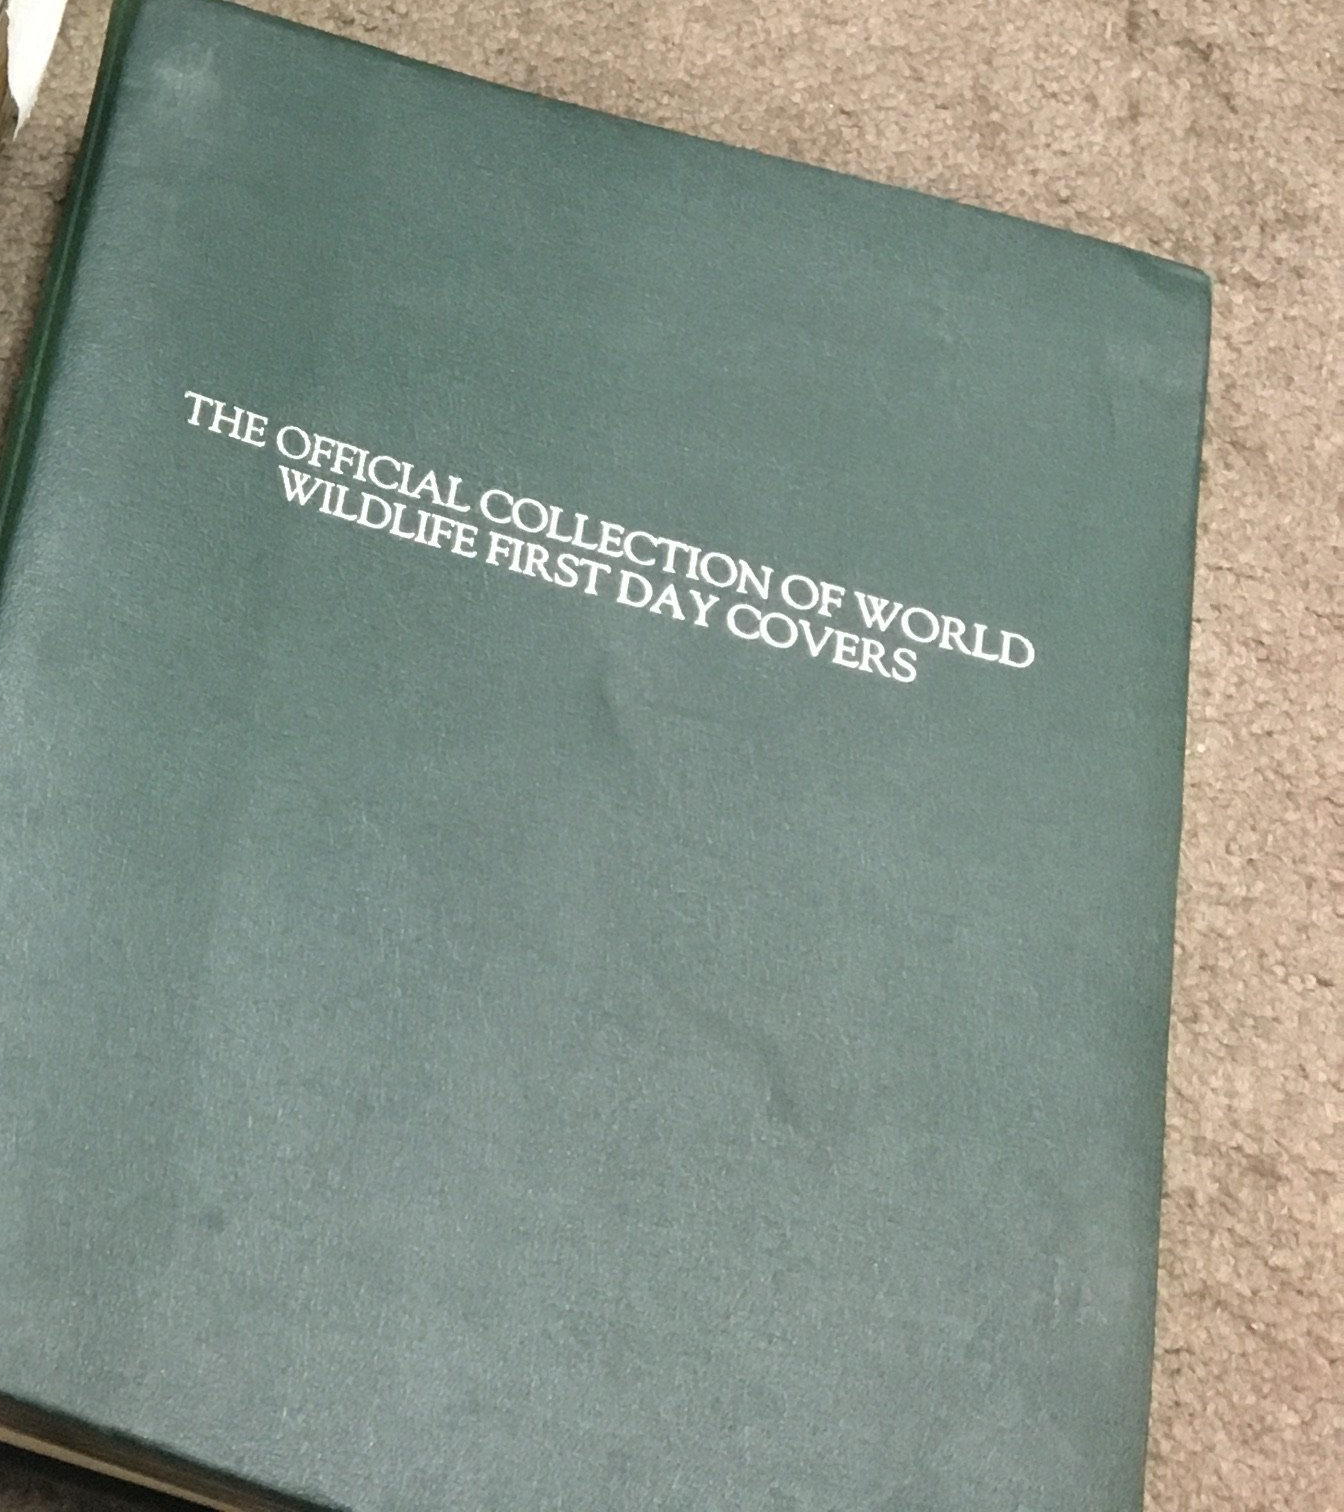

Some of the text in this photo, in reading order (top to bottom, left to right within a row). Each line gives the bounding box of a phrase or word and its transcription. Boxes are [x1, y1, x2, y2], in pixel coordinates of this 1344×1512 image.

[184, 389, 1036, 671] THE OFFICIAL COLLECTION OF WORLD
[276, 464, 918, 684] WILDLIFE FIRST DAY COVERS
